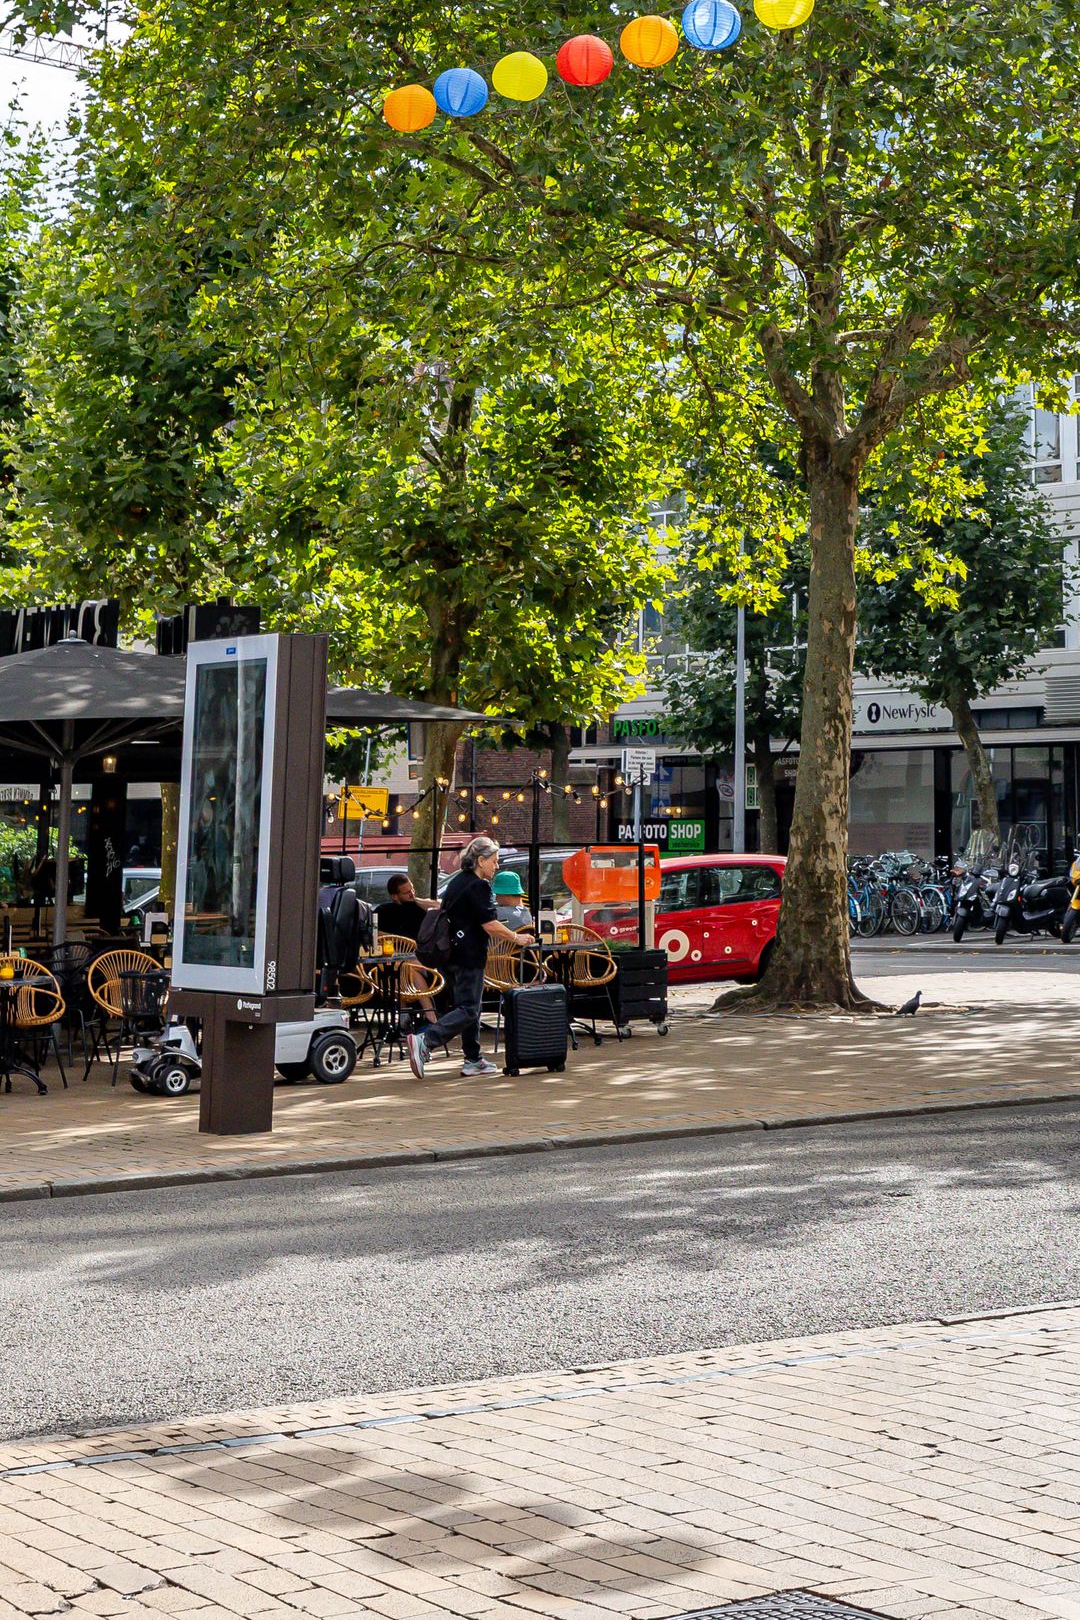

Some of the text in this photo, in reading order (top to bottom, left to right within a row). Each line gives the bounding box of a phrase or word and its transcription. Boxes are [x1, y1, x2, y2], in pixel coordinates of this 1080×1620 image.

[613, 718, 657, 737] PASFO
[670, 824, 702, 840] SHOP
[266, 960, 277, 990] 98502
